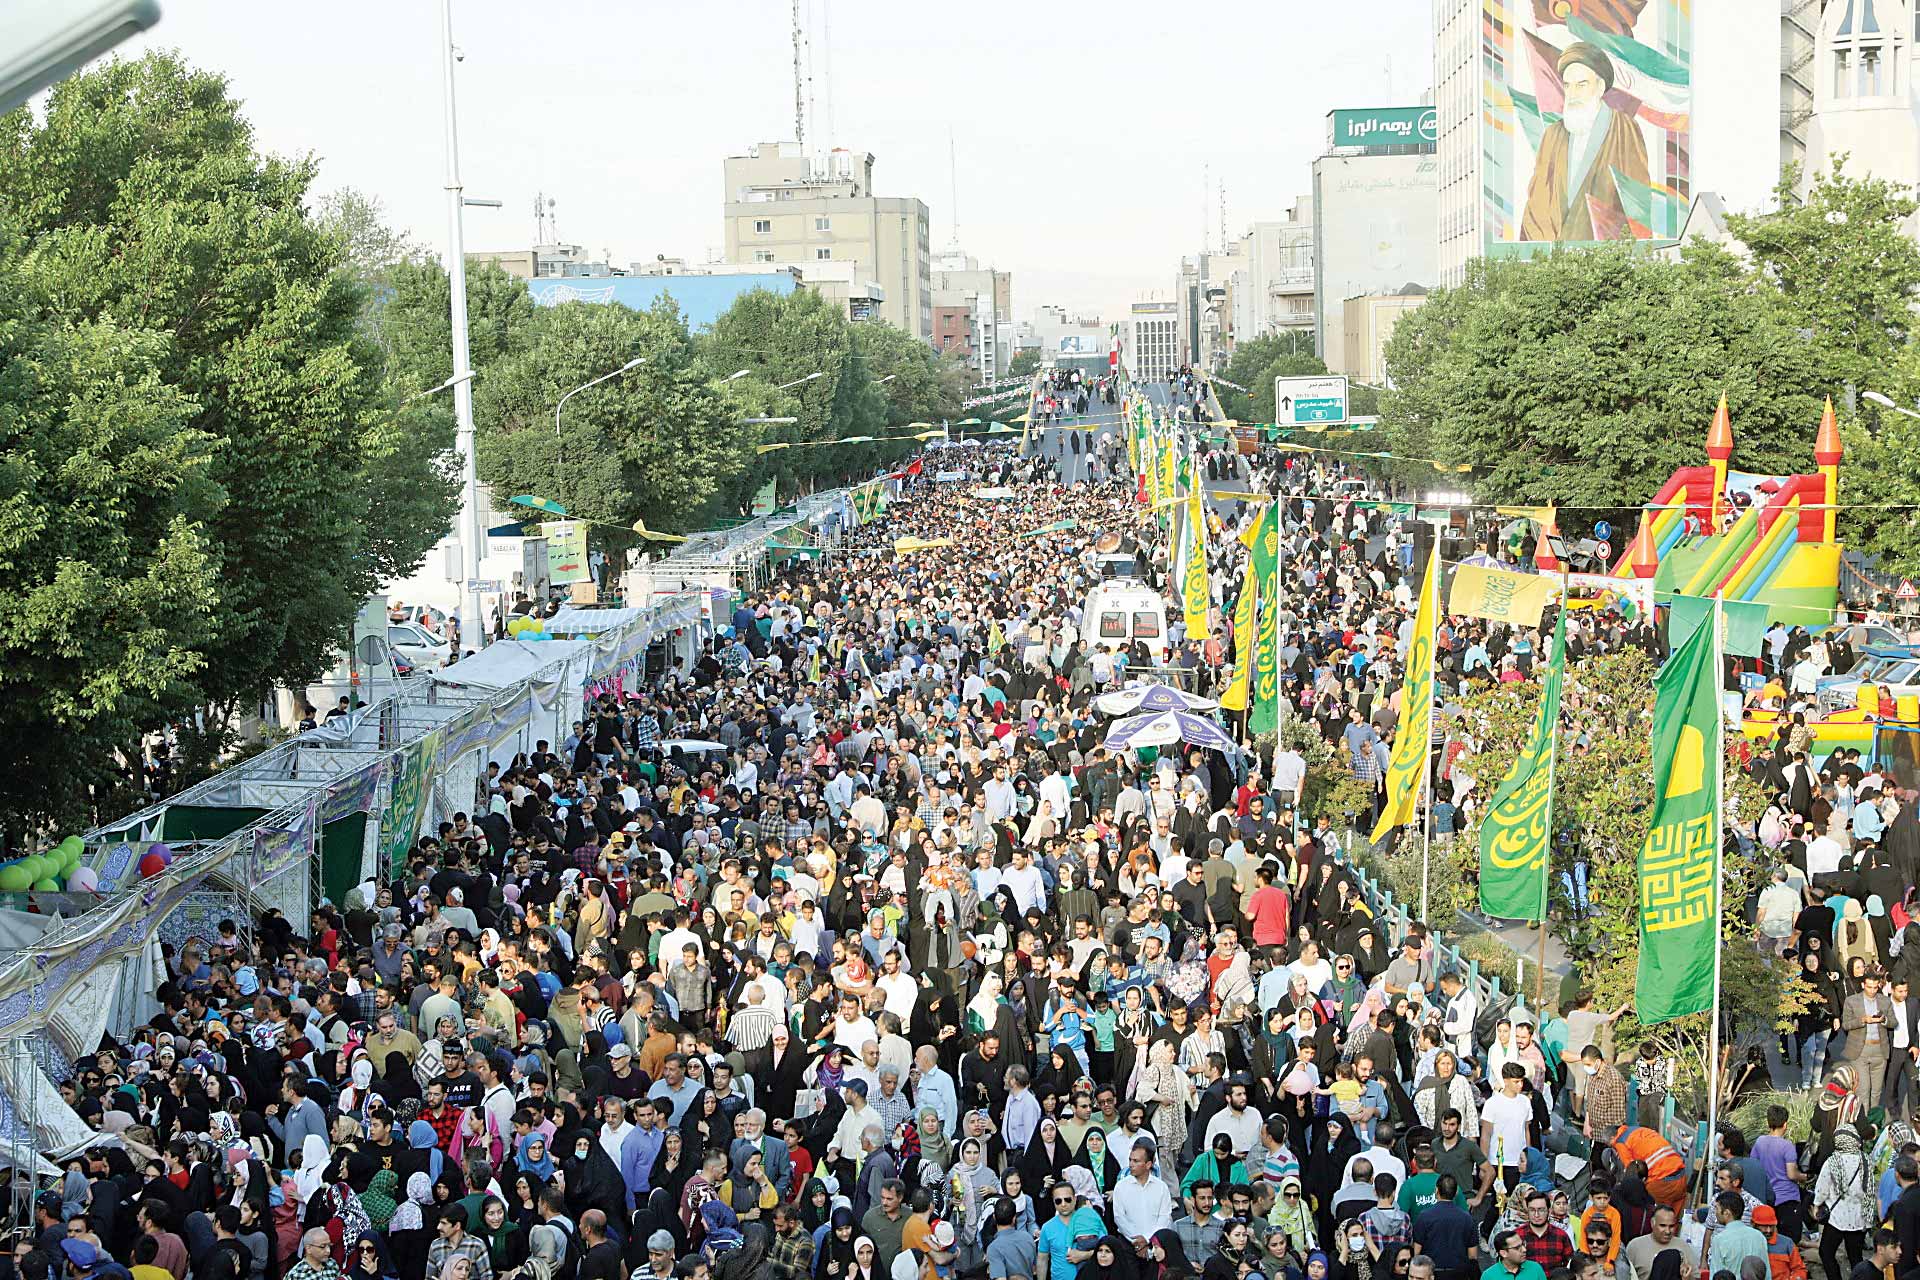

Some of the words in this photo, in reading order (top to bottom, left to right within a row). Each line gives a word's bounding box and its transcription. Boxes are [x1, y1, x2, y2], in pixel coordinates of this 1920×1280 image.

[1348, 119, 1377, 137] البرز
[1379, 120, 1412, 136] بیمه
[452, 1084, 472, 1093] ARE
